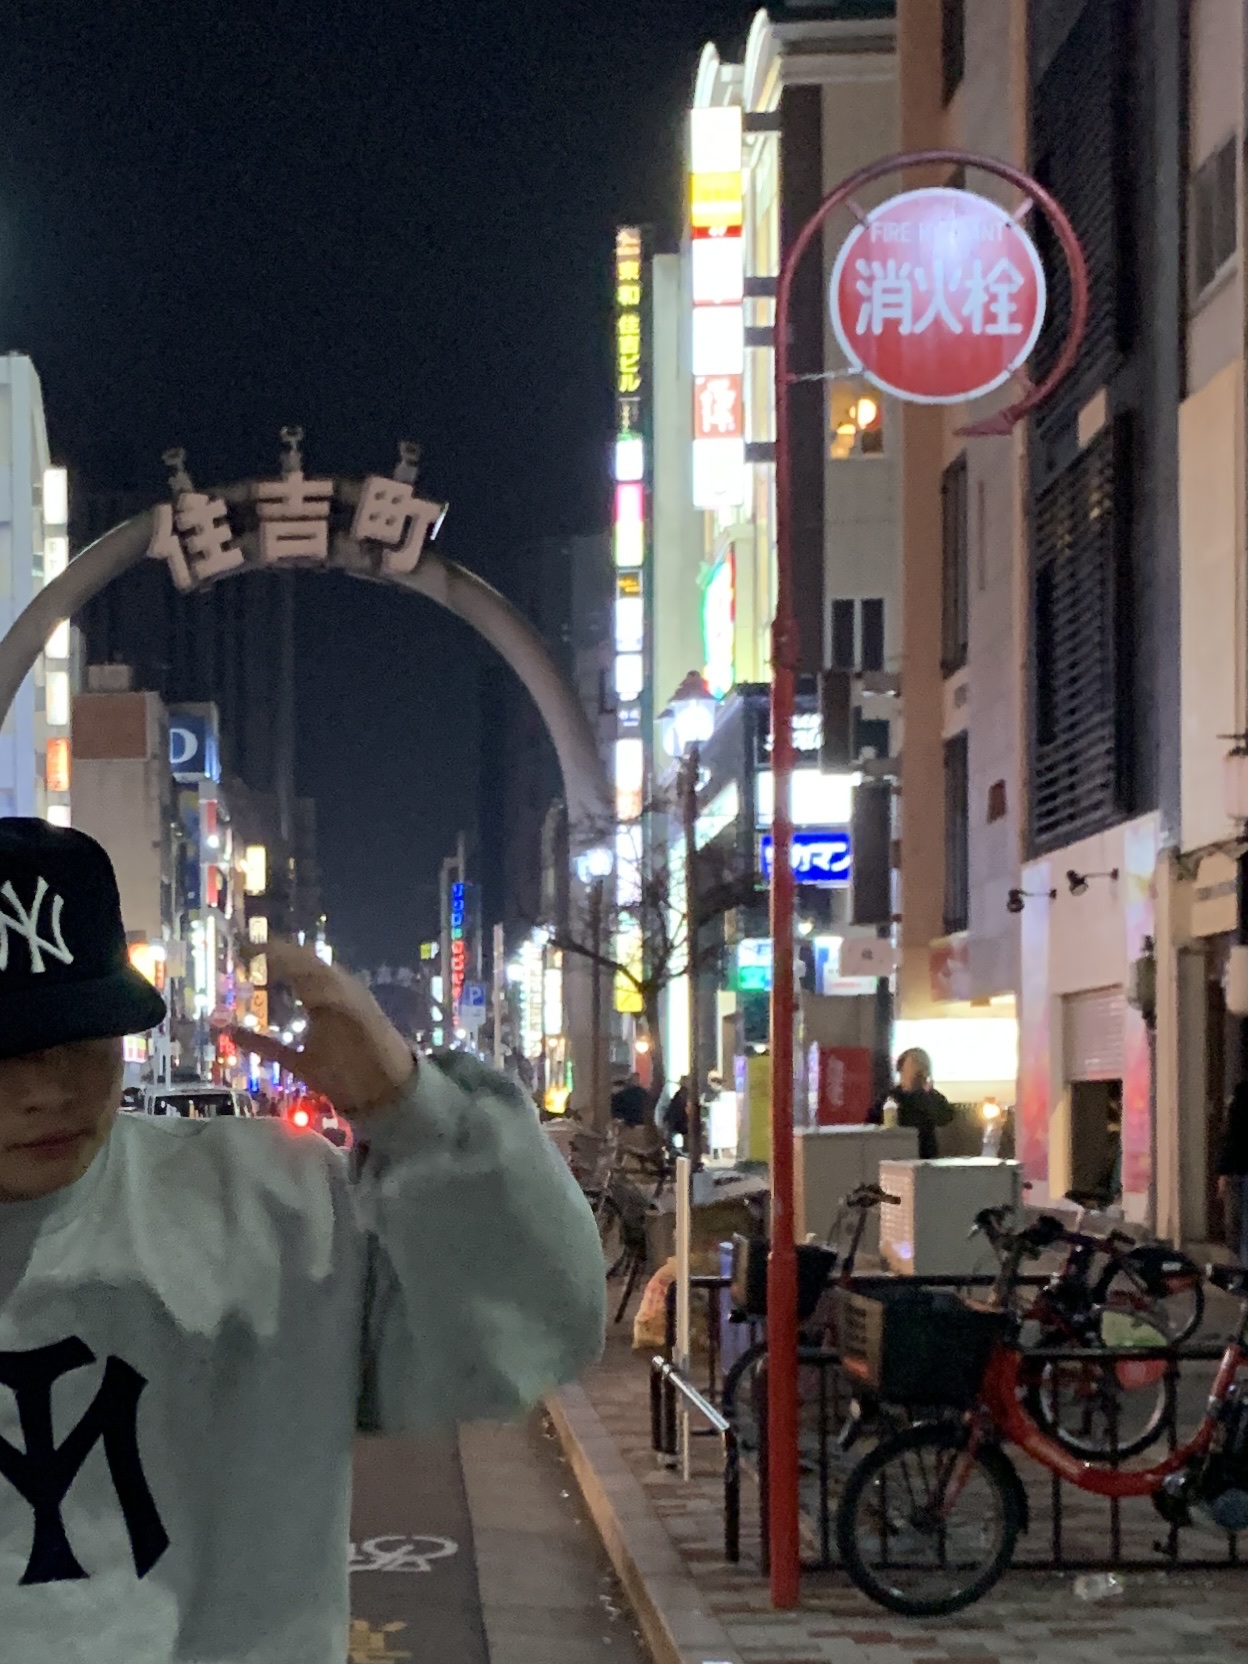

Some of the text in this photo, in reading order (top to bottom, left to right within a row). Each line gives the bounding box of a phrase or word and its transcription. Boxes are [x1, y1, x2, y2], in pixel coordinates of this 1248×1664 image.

[870, 222, 911, 243] FIRE
[854, 256, 1025, 336] 消火栓
[146, 472, 444, 592] 住吉町
